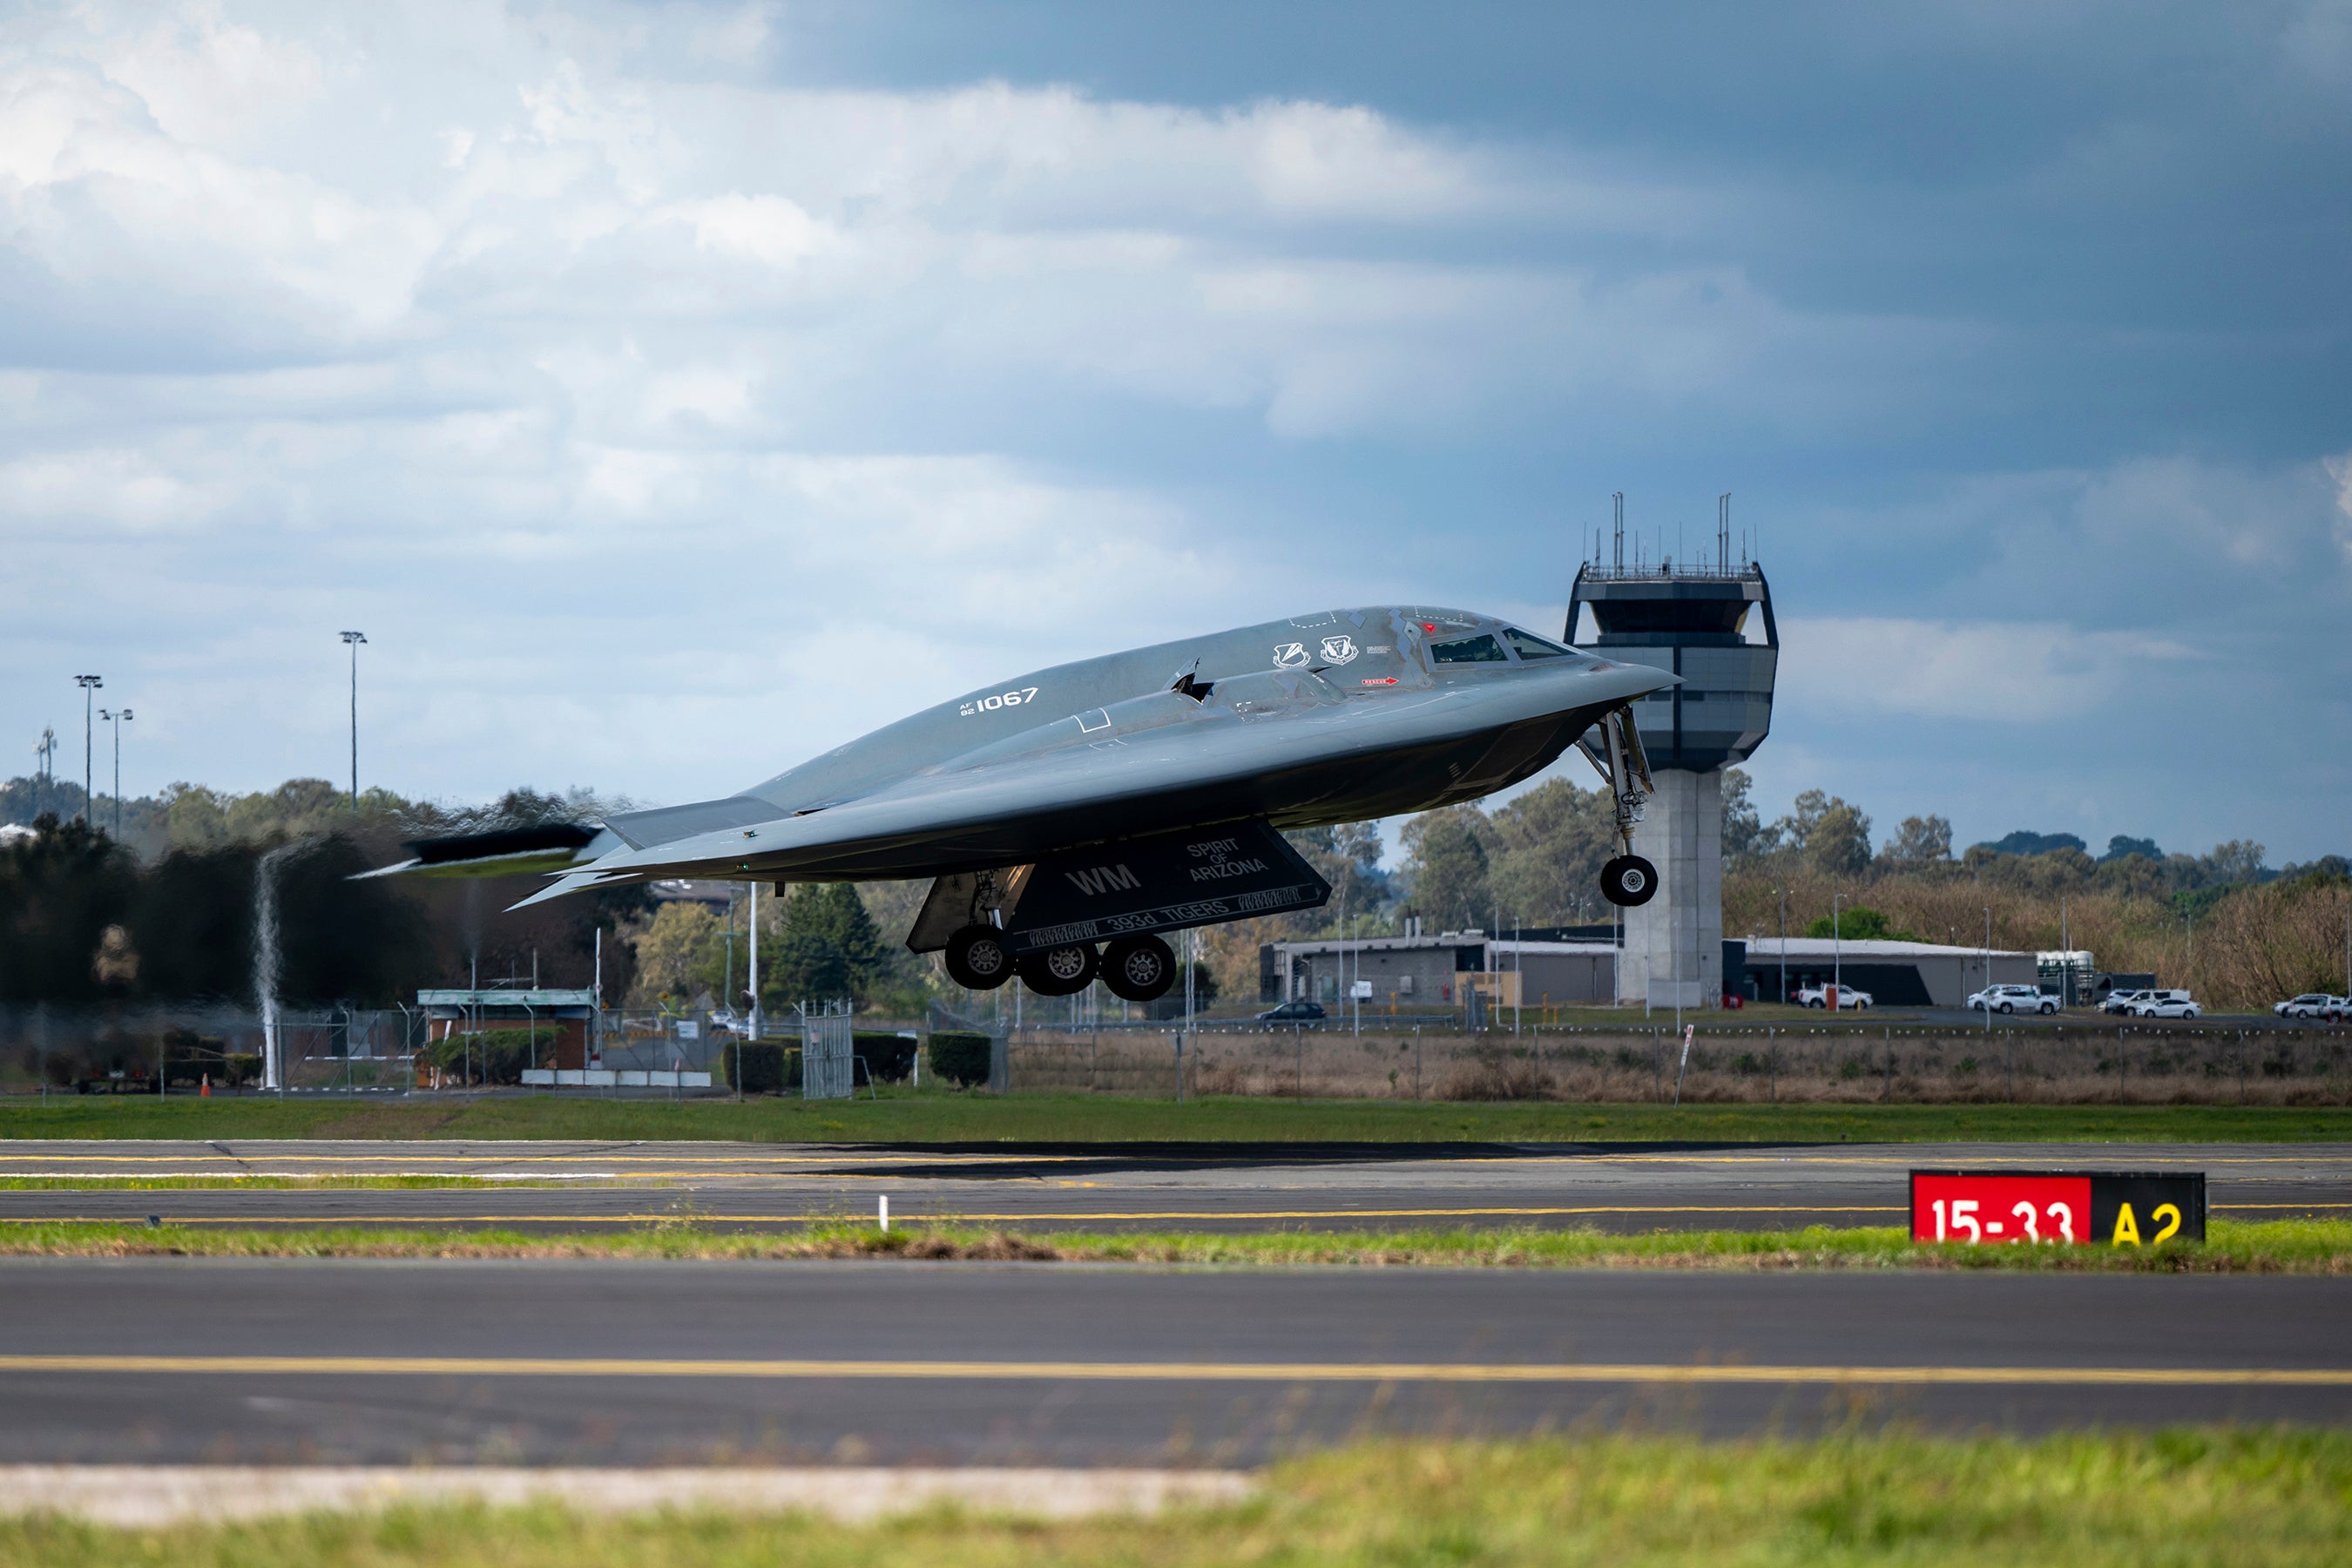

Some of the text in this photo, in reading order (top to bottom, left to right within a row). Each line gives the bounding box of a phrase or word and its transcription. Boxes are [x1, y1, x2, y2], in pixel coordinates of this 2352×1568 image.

[977, 686, 1038, 713] 1067
[1186, 838, 1239, 857] SPIRIT
[1209, 853, 1227, 865] OF
[1064, 863, 1142, 896] WM
[1189, 858, 1269, 882] ARIZONA
[1107, 901, 1230, 931] 393d TIGERS
[1932, 1200, 2075, 1247] 15-33
